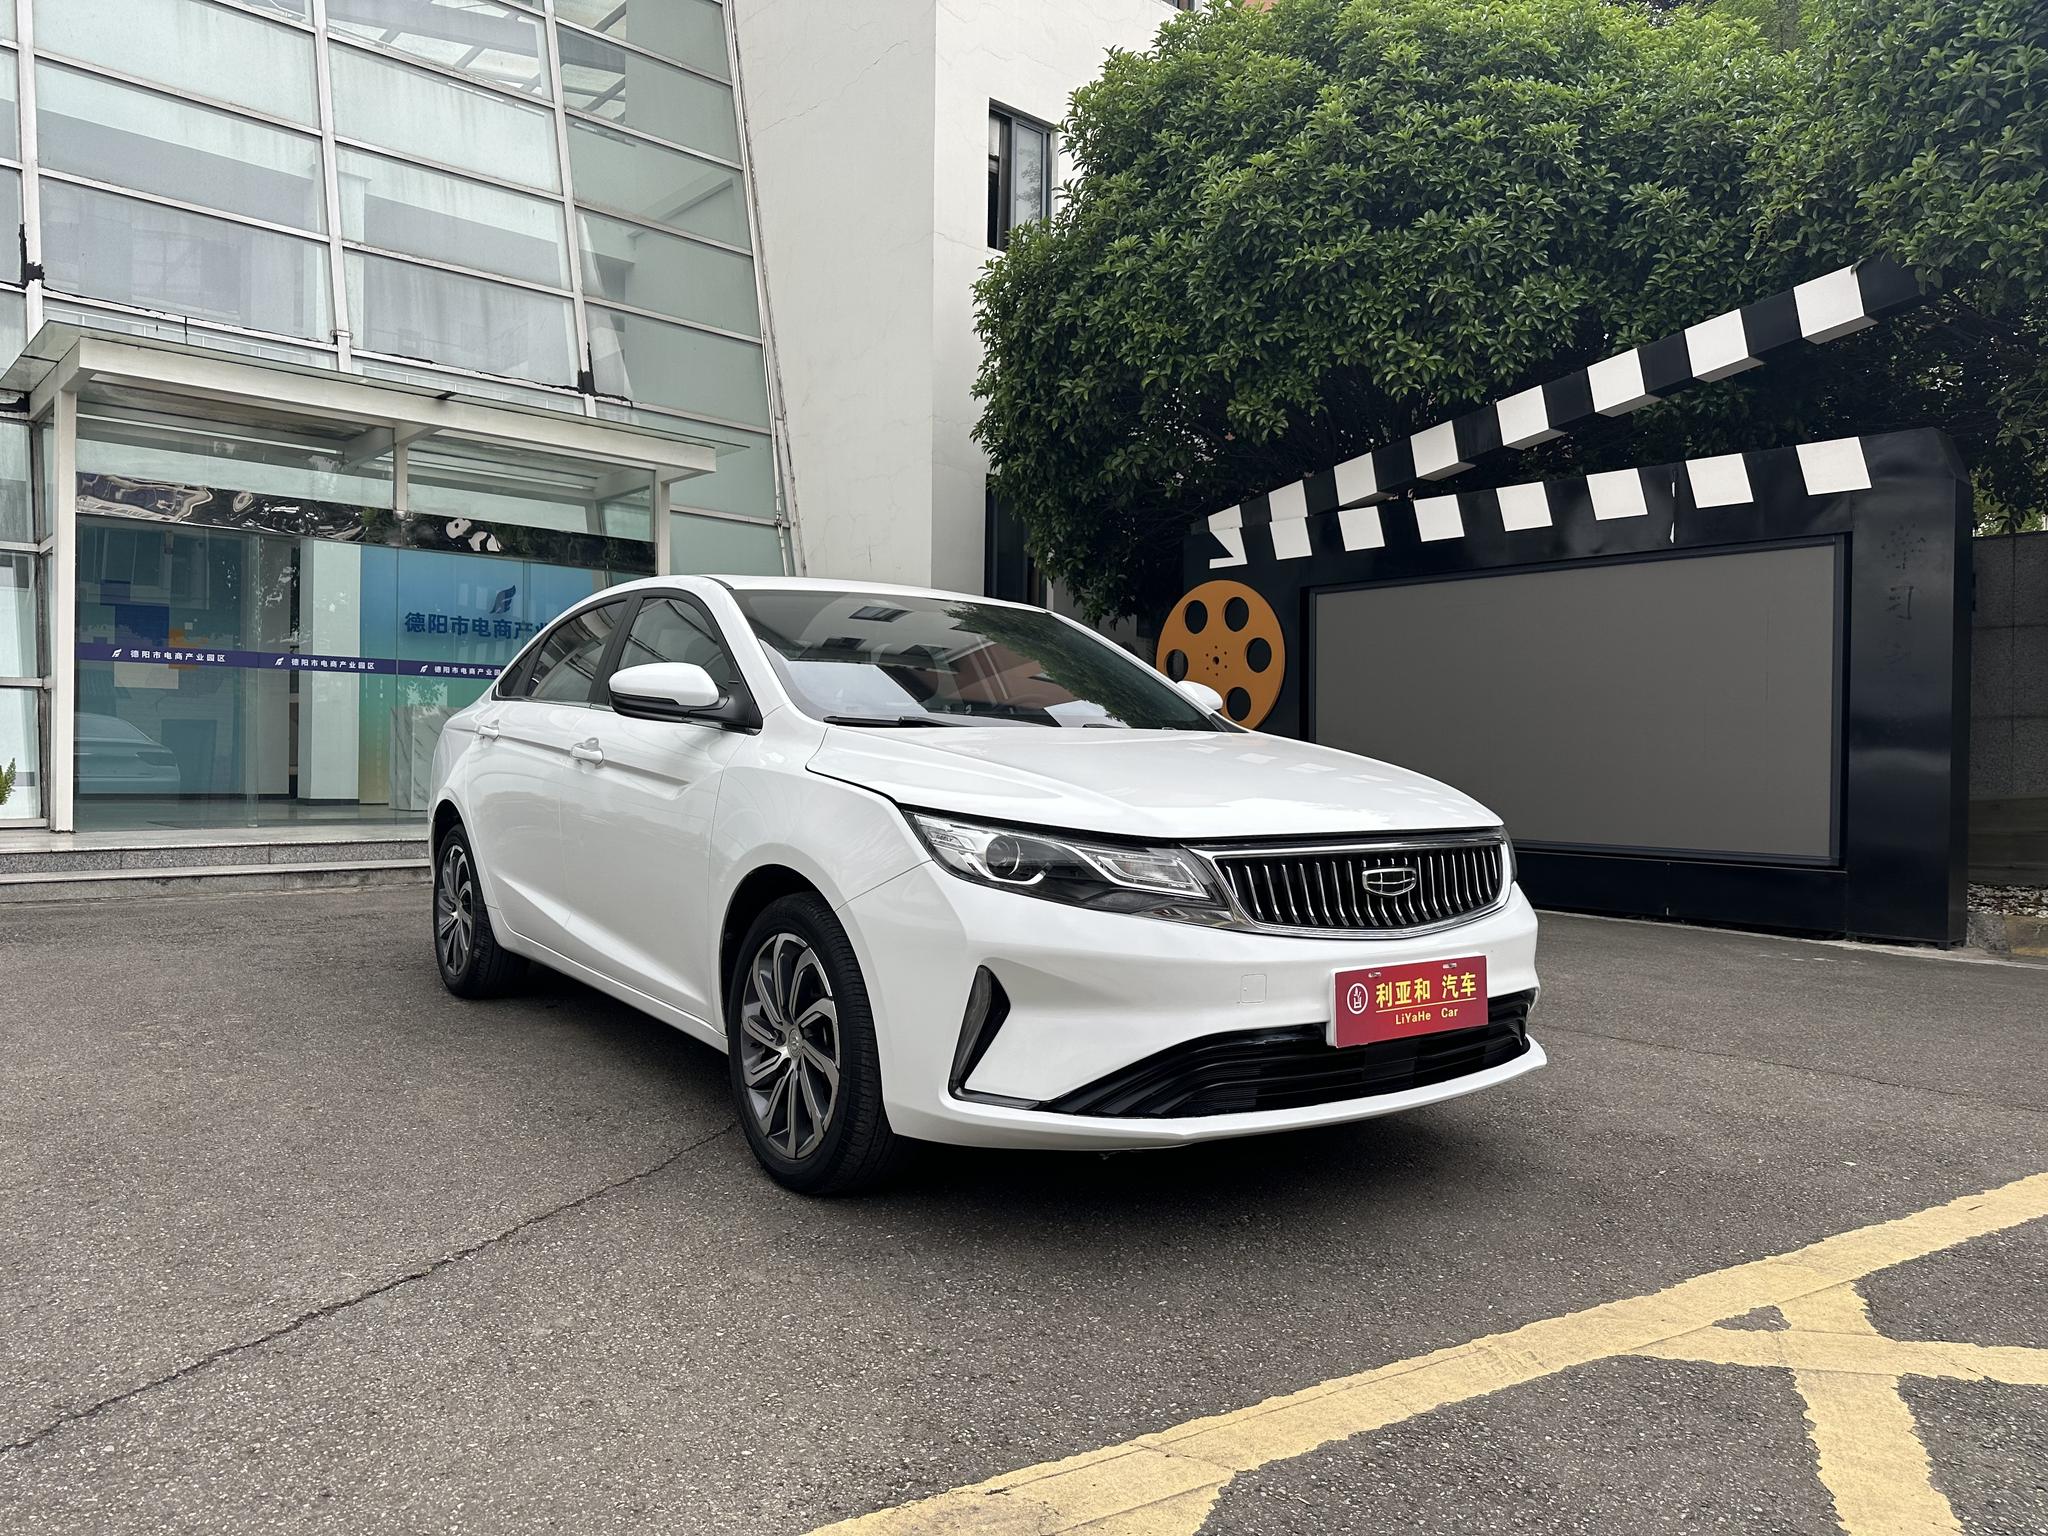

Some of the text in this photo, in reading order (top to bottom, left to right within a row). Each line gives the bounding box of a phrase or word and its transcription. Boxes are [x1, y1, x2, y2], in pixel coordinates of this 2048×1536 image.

[130, 649, 226, 663] 德阳市电商产业园区
[291, 658, 376, 670] 德阳市电商产业园区
[1376, 971, 1477, 1009] 利亚和 汽车
[1395, 1007, 1459, 1025] LiYaHe Car
